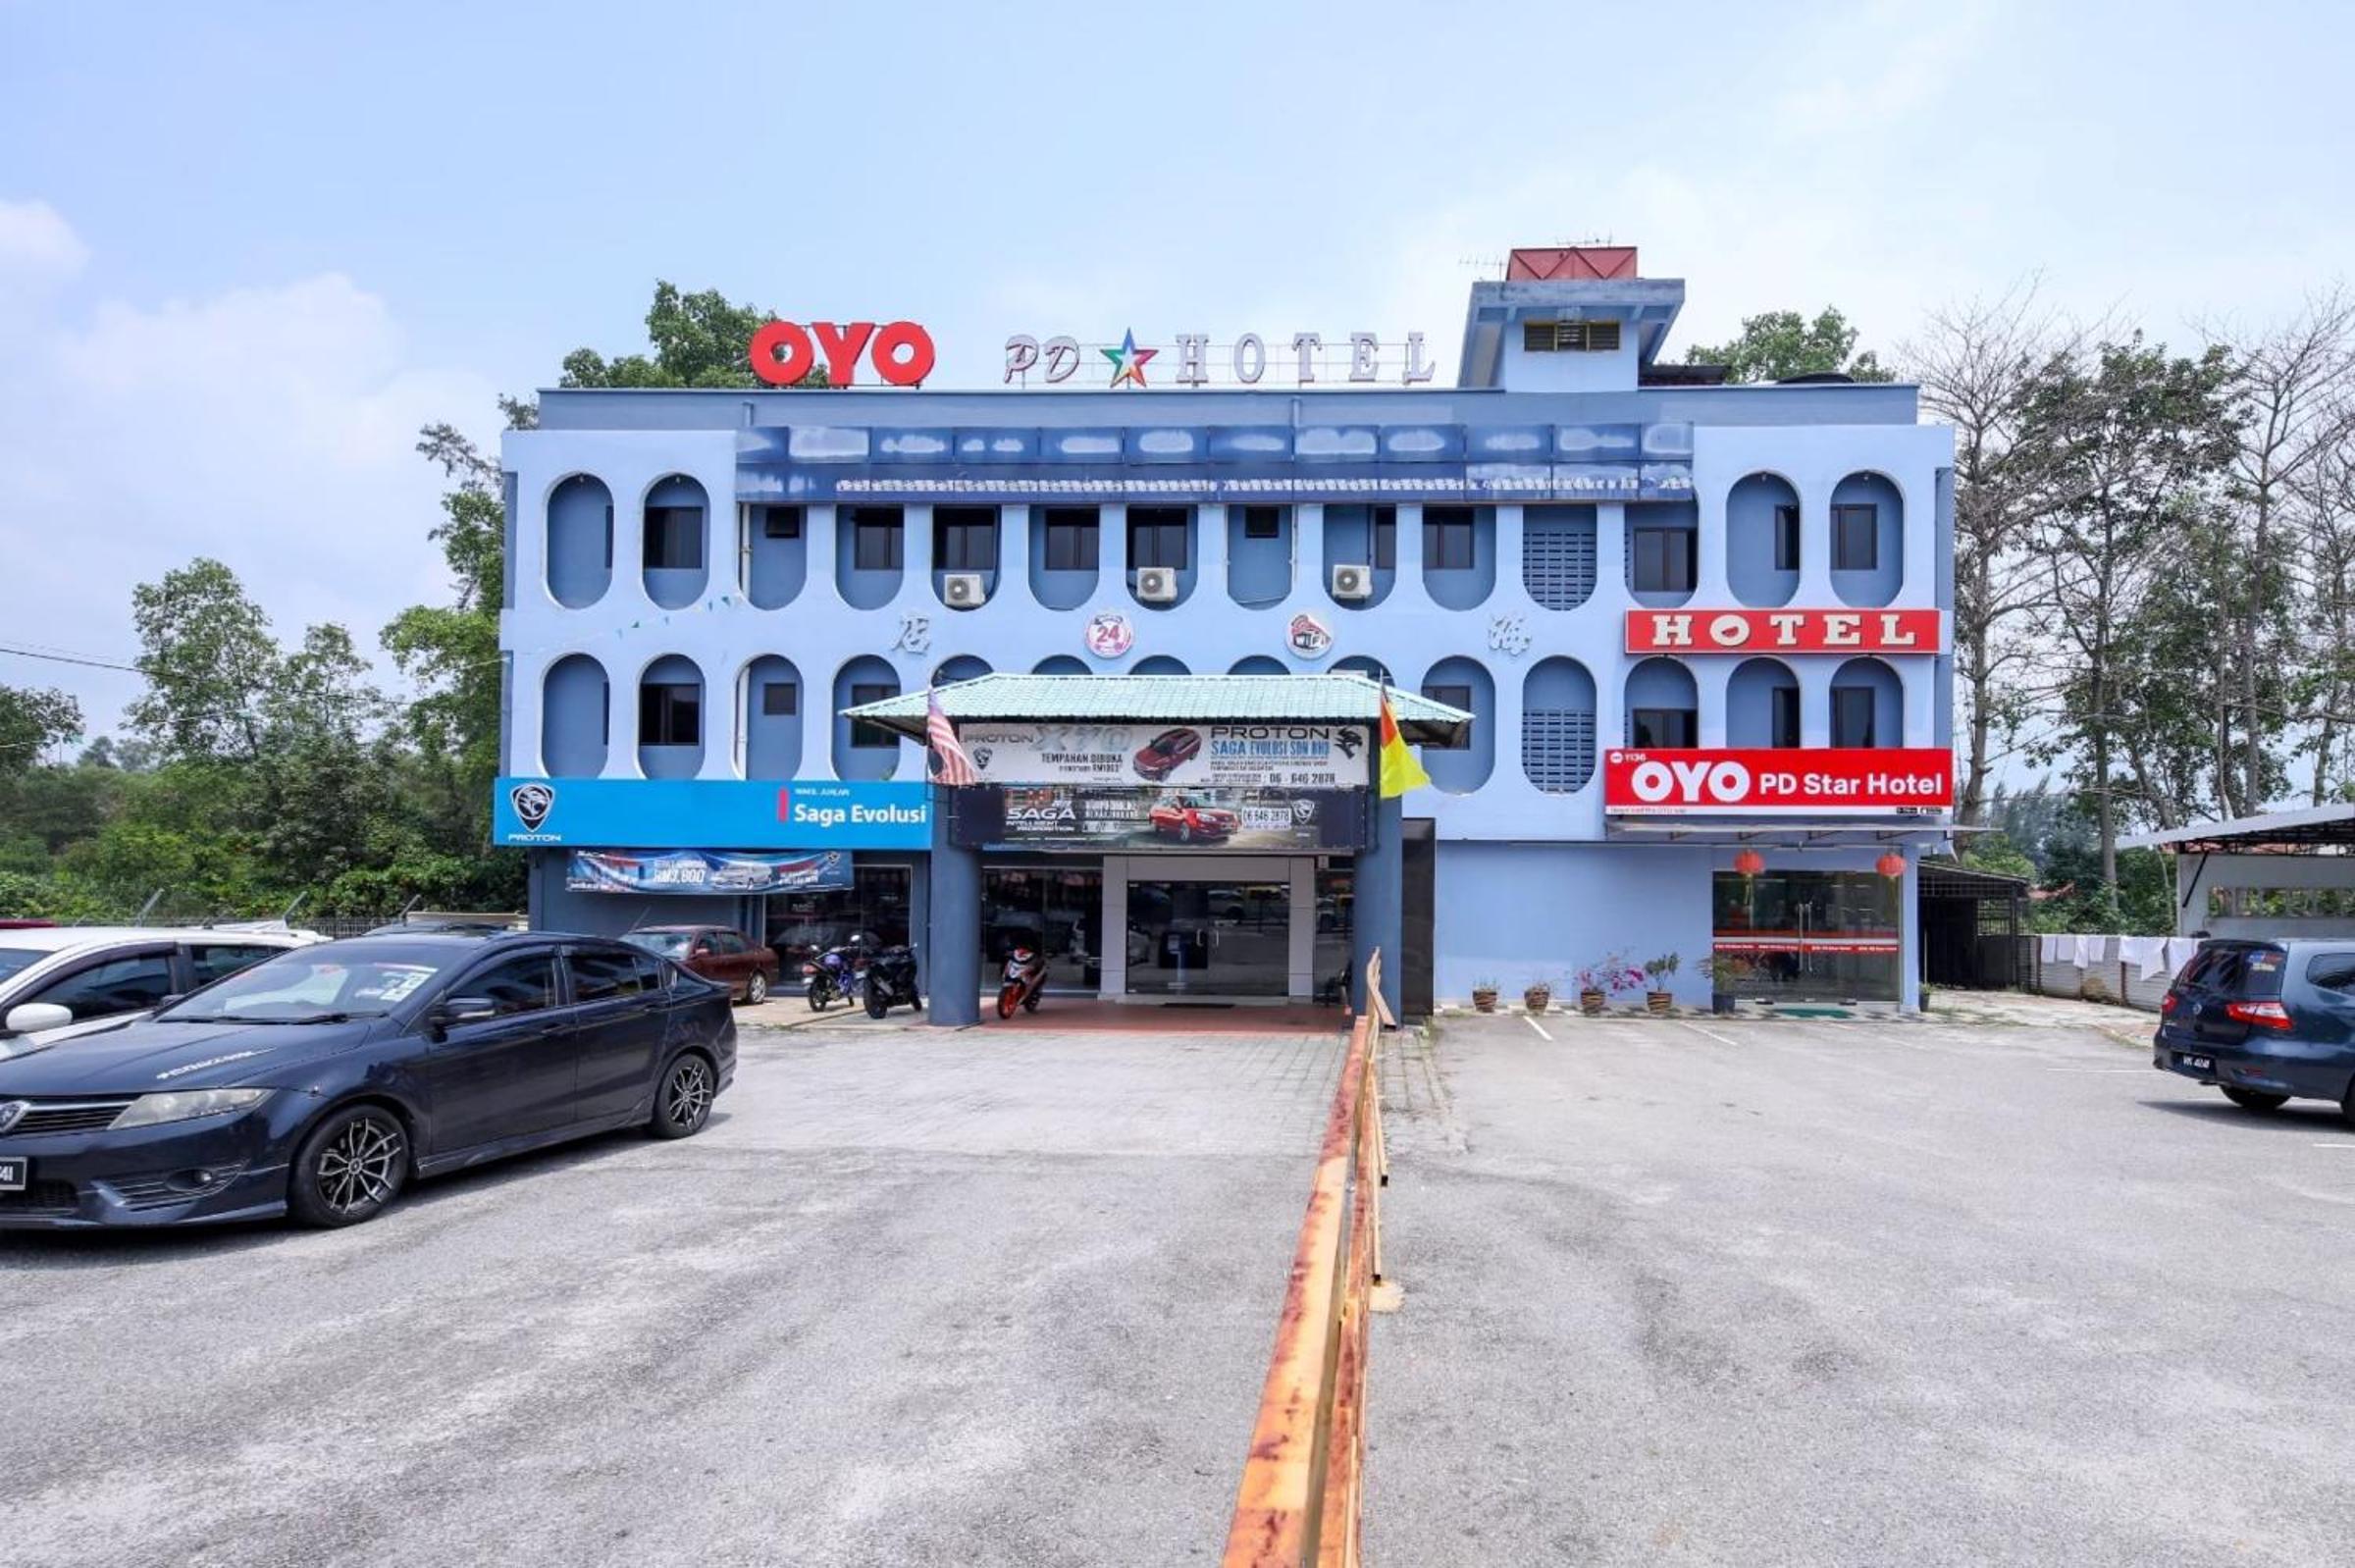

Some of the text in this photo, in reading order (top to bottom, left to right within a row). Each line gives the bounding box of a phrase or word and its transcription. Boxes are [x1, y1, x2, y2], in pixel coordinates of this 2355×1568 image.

[749, 321, 935, 386] OYO
[1005, 332, 1436, 384] PD HOTEL
[1096, 625, 1121, 643] 24
[1651, 614, 1915, 647] HOTEL
[1211, 727, 1329, 739] PROTON
[1211, 741, 1246, 756] SAGA
[1631, 761, 1943, 802] OYO PD Star Hotel
[794, 804, 927, 827] Saga Evolusi
[1006, 808, 1075, 820] SAGA
